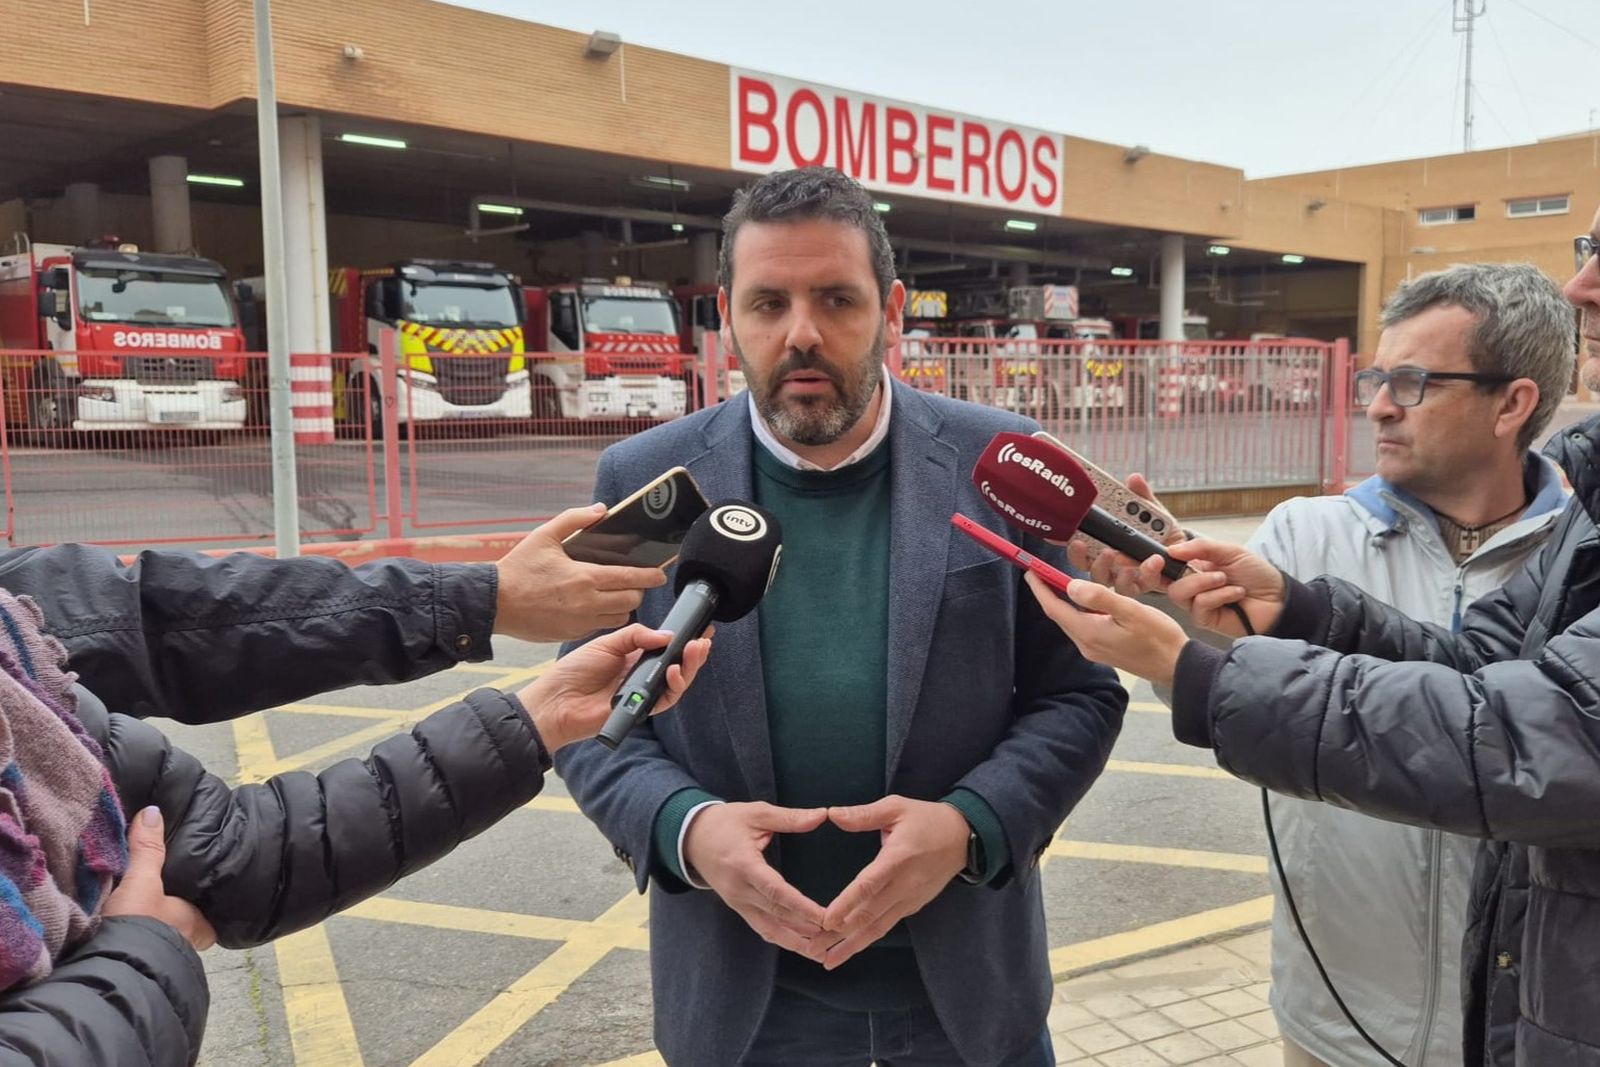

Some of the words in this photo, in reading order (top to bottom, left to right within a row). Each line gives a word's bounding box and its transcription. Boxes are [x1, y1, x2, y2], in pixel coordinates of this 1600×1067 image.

[738, 76, 1057, 207] BOMBEROS
[1011, 452, 1075, 497] esRadio
[726, 514, 753, 528] intv
[988, 492, 1052, 532] esRadio
